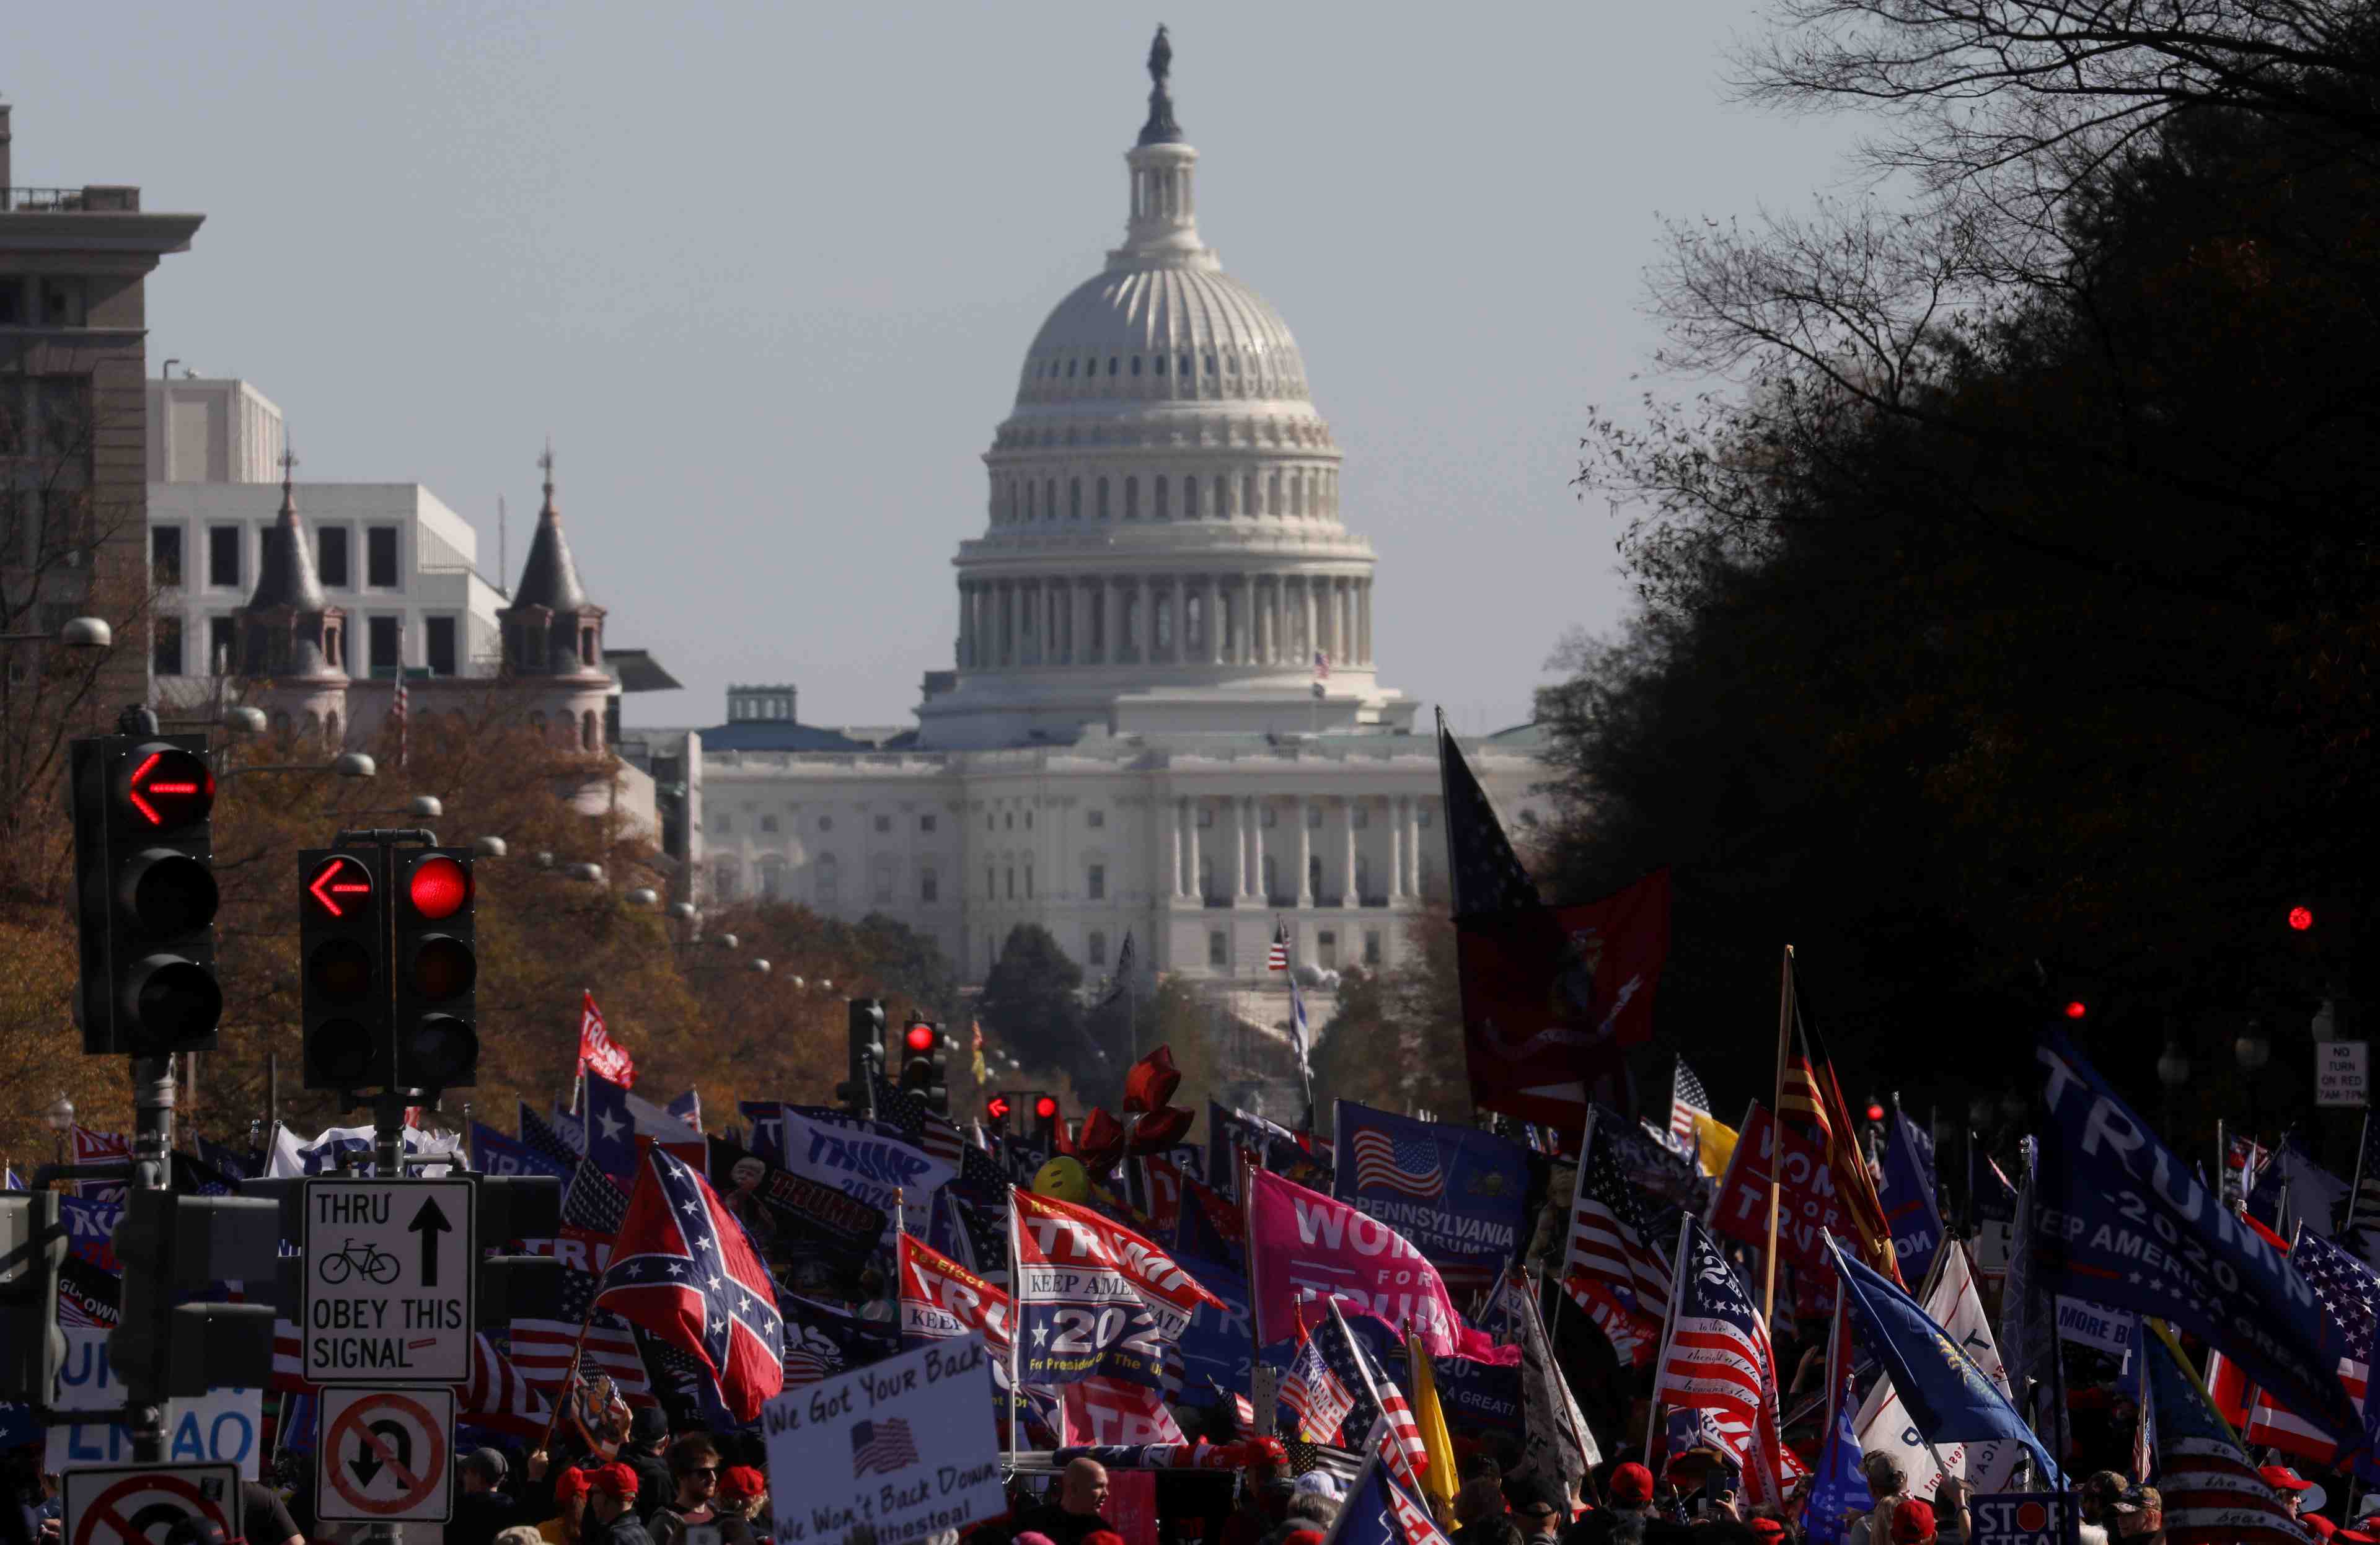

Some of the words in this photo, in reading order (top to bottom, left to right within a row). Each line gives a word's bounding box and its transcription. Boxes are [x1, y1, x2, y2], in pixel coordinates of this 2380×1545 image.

[2330, 1061, 2356, 1071] TURN
[2333, 1047, 2350, 1057] NO
[2321, 1076, 2336, 1086] ON
[2341, 1076, 2362, 1086] RED
[317, 1193, 390, 1224] THRU
[1356, 1197, 1514, 1248] PENNSYLVANIA
[1031, 1275, 1079, 1293] KEEP
[1377, 1270, 1433, 1288] FOR
[314, 1299, 388, 1329] OBEY
[400, 1299, 462, 1329] THIS
[2059, 1306, 2111, 1339] MORE
[1051, 1307, 1162, 1358] 202
[313, 1337, 414, 1368] SIGNAL
[1115, 1354, 1142, 1370] The
[765, 1398, 801, 1436] We
[809, 1384, 853, 1423] Got
[923, 1342, 984, 1383] Back
[1460, 1391, 1518, 1417] GREAT!
[775, 1517, 806, 1544] We
[812, 1494, 875, 1534] Won't
[879, 1479, 930, 1514] Back
[937, 1463, 997, 1495] Down
